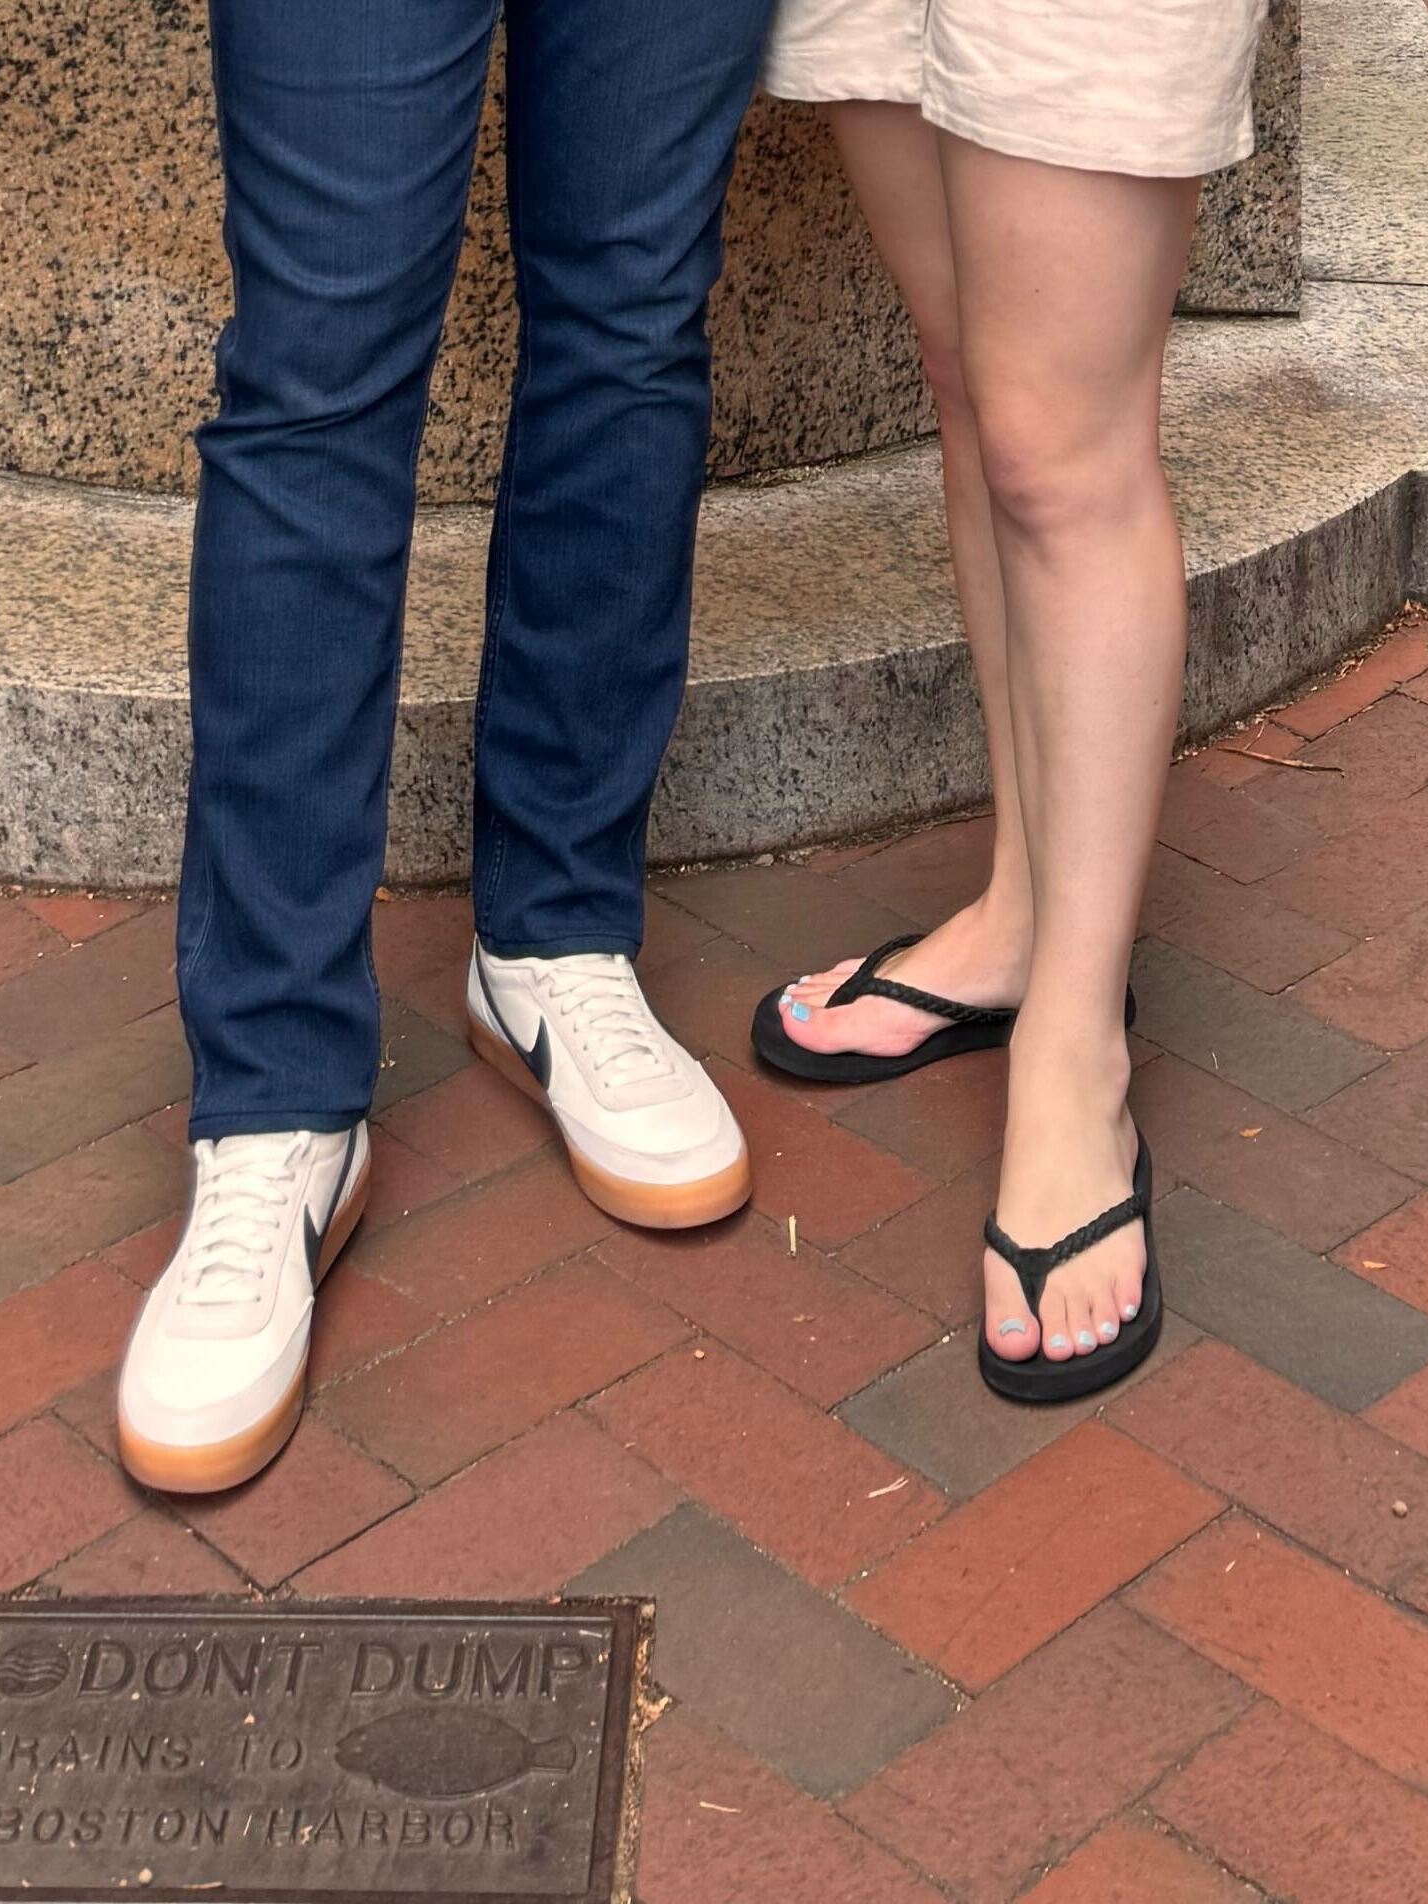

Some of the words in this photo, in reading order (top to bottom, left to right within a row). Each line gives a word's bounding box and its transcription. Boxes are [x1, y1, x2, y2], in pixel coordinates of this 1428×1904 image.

[348, 1641, 592, 1697] DUMP
[230, 1733, 303, 1772] TO
[262, 1803, 517, 1849] HARBOR
